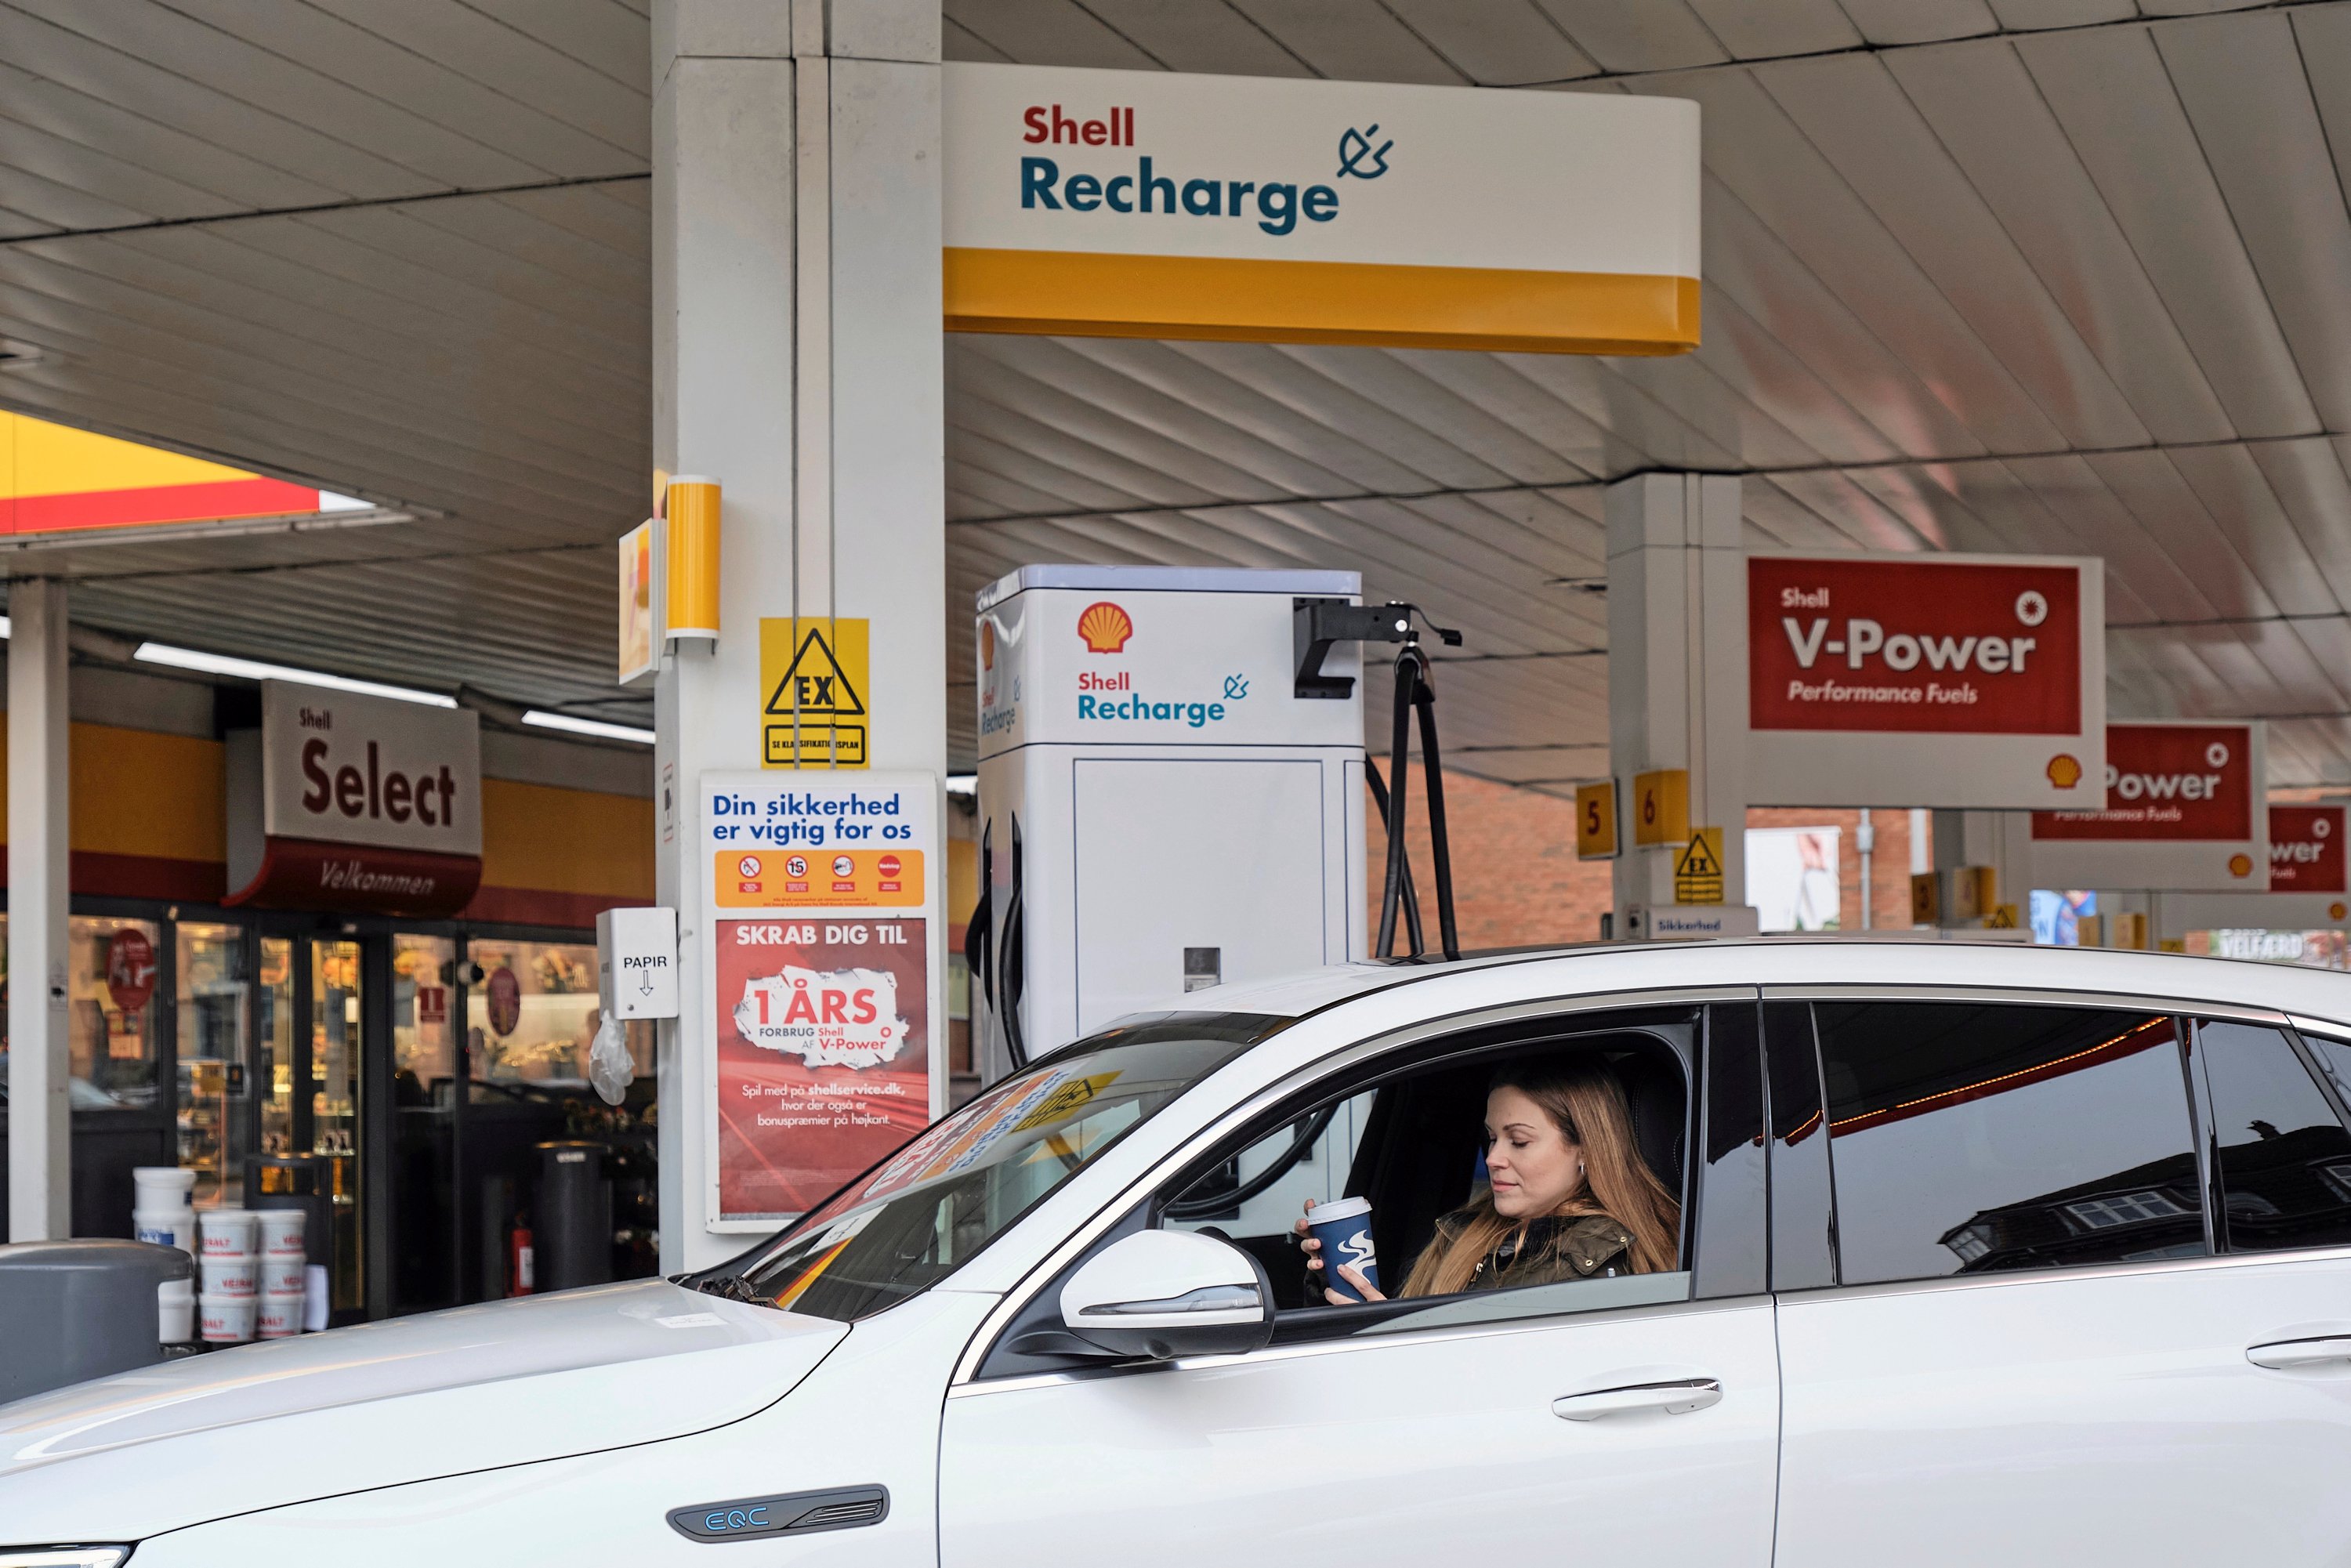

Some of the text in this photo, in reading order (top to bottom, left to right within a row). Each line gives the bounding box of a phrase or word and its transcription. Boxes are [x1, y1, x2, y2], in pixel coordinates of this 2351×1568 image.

[1023, 104, 1134, 147] Shell
[1021, 156, 1339, 236] Recharge
[1780, 587, 1830, 609] Shell
[1781, 617, 2037, 674] V-Power
[796, 676, 834, 705] EX
[1078, 672, 1130, 690] Shell
[1787, 679, 1978, 704] Performance Fuels
[299, 708, 331, 730] Shell
[1078, 693, 1225, 728] Recharge
[302, 737, 455, 827] Select
[713, 793, 899, 816] Din sikkerhed
[1643, 789, 1656, 827] 6
[2146, 806, 2183, 822] Fuels
[1586, 800, 1600, 836] 5
[712, 817, 911, 846] er vigtig for os
[788, 861, 804, 874] 15
[1690, 857, 1708, 872] EX
[320, 860, 436, 895] Velkommen
[736, 925, 907, 945] SKRAB DIG TIL
[1658, 920, 1721, 932] Sikkerhed
[624, 956, 667, 969] PAPIR
[754, 978, 877, 1024] 1 ÅRS
[759, 1027, 843, 1037] FORBRUG Shell
[802, 1038, 886, 1050] AF V-Power
[742, 1082, 905, 1099] Spil med på shellservice.dk,
[781, 1099, 867, 1113] hvor der også er
[757, 1114, 831, 1128] bonuspræmier
[834, 1114, 848, 1128] på
[705, 1507, 770, 1530] EQC
